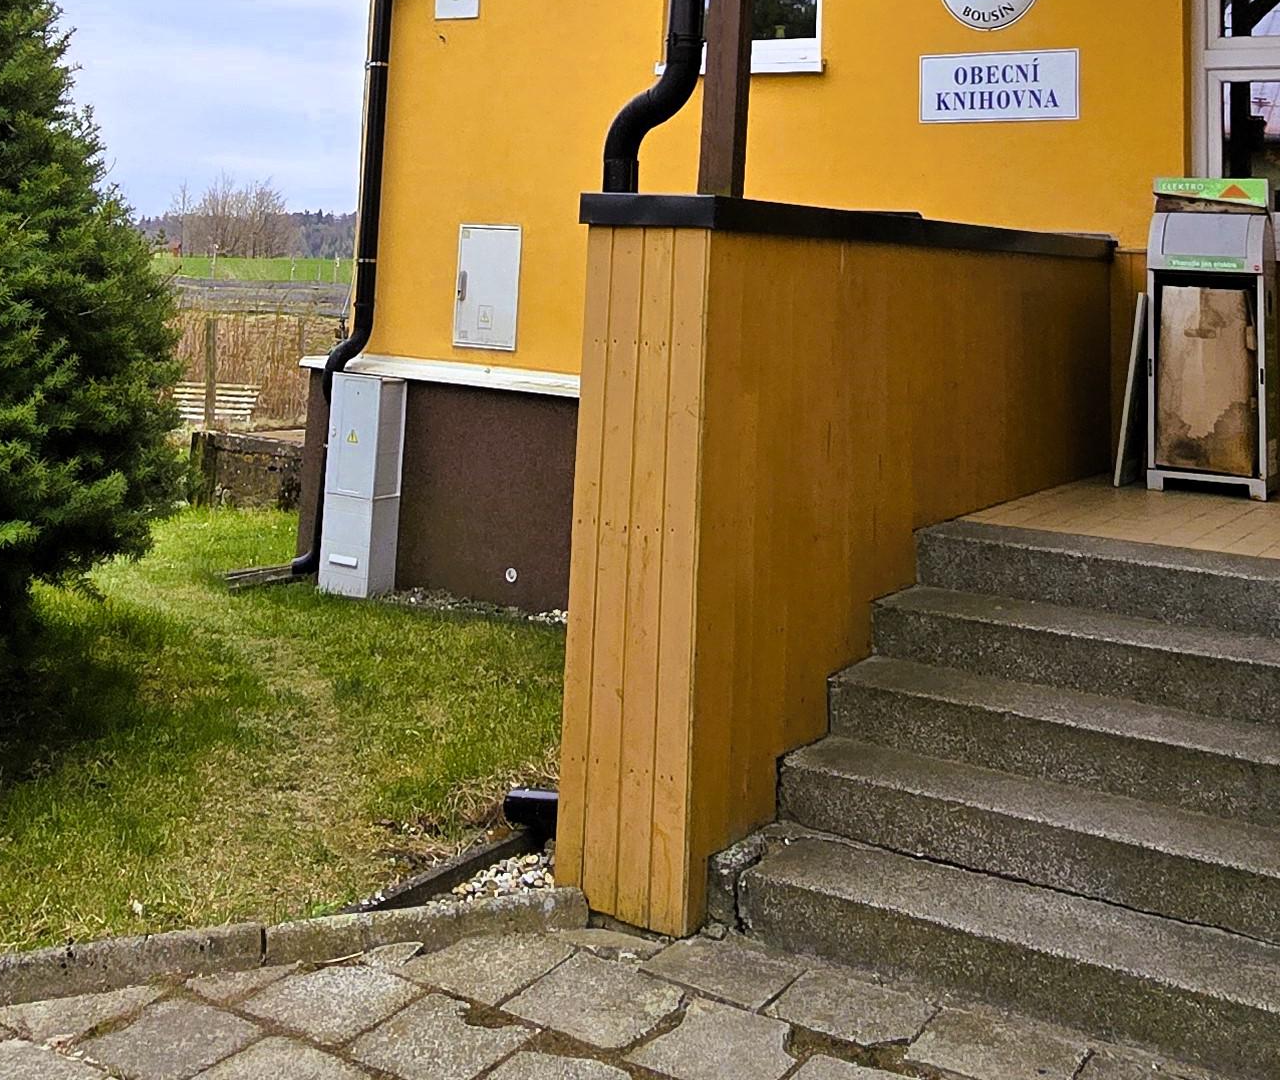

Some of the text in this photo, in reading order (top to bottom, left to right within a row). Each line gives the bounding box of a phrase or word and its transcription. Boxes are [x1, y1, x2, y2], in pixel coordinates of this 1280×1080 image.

[962, 3, 1015, 23] BOUSÍN
[953, 58, 1040, 85] OBECNÍ
[935, 89, 1060, 111] KNIHOVNA
[1161, 182, 1205, 192] ELEKTRO
